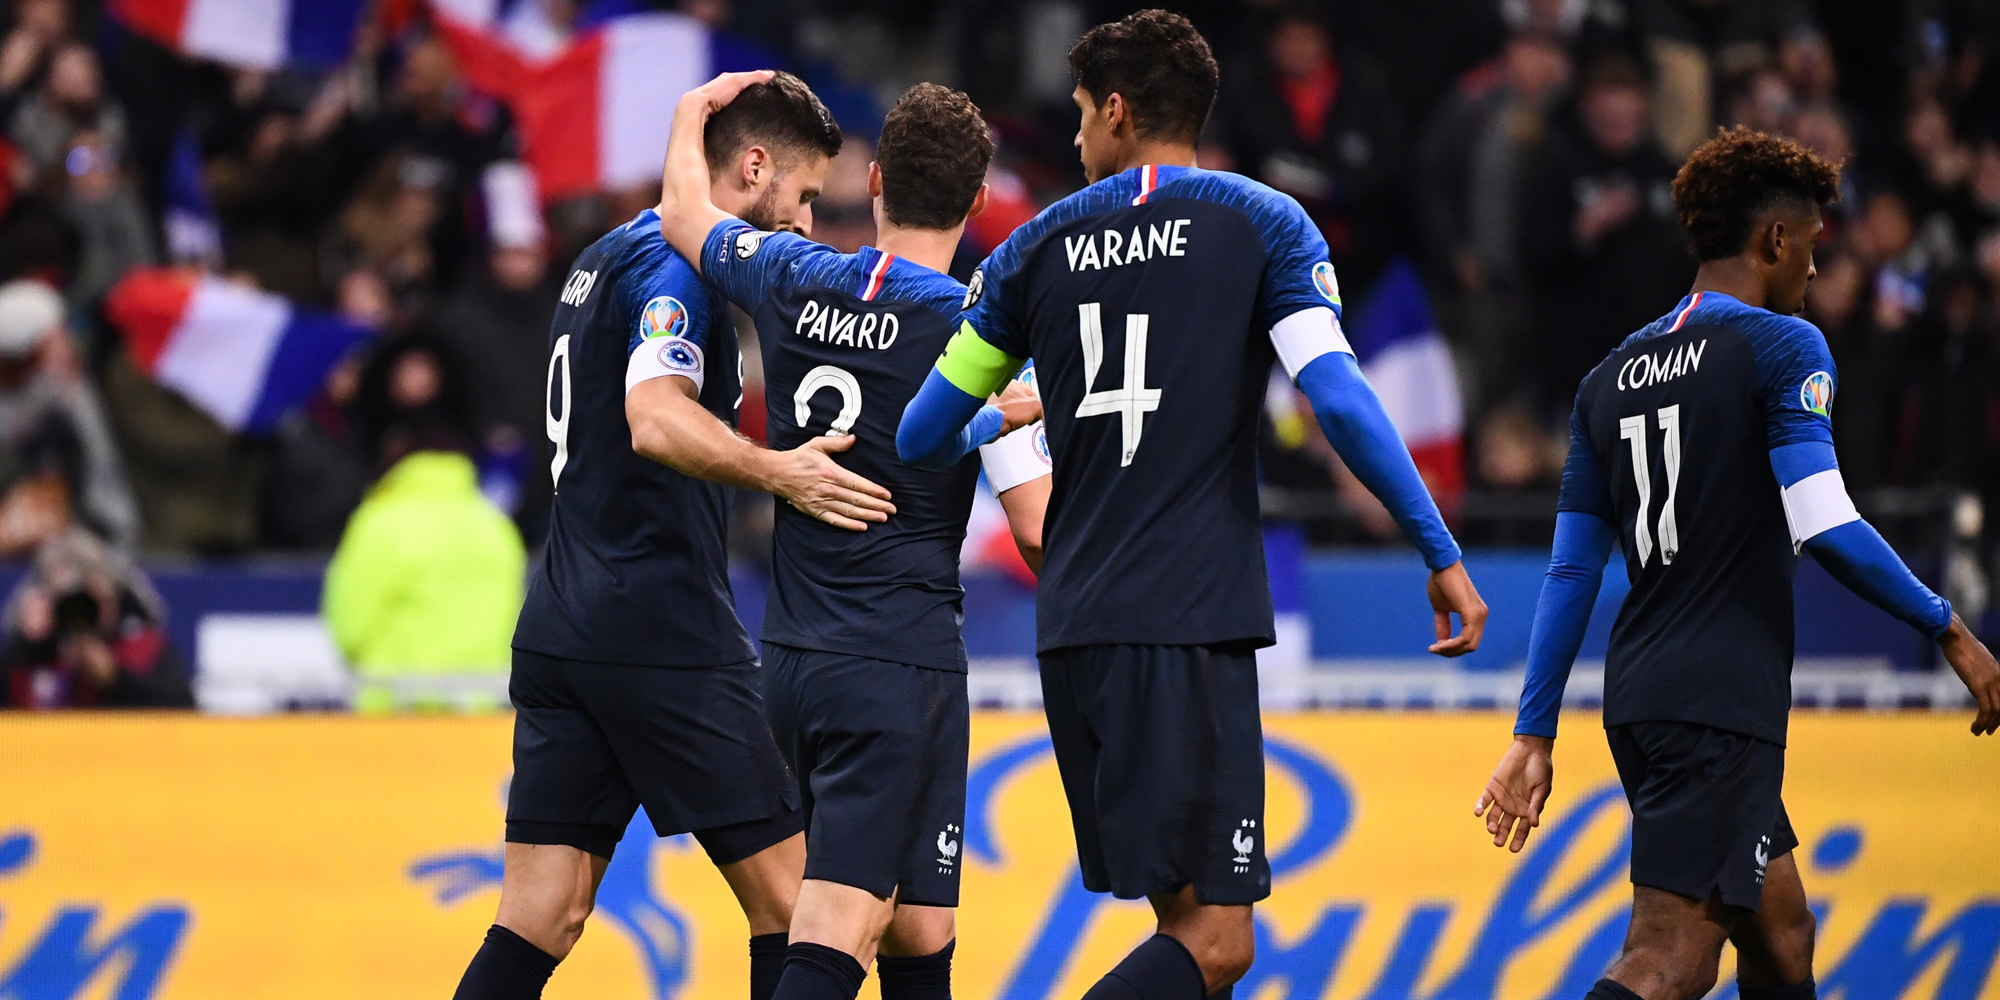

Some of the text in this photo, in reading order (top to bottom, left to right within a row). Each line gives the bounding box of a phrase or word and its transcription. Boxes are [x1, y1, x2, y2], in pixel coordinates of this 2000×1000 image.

[1064, 218, 1191, 273] VARANE
[795, 300, 899, 350] PAVARD
[1617, 339, 1707, 391] COMAN
[546, 334, 571, 495] 9
[1075, 302, 1162, 468] 4
[1619, 403, 1680, 569] 11
